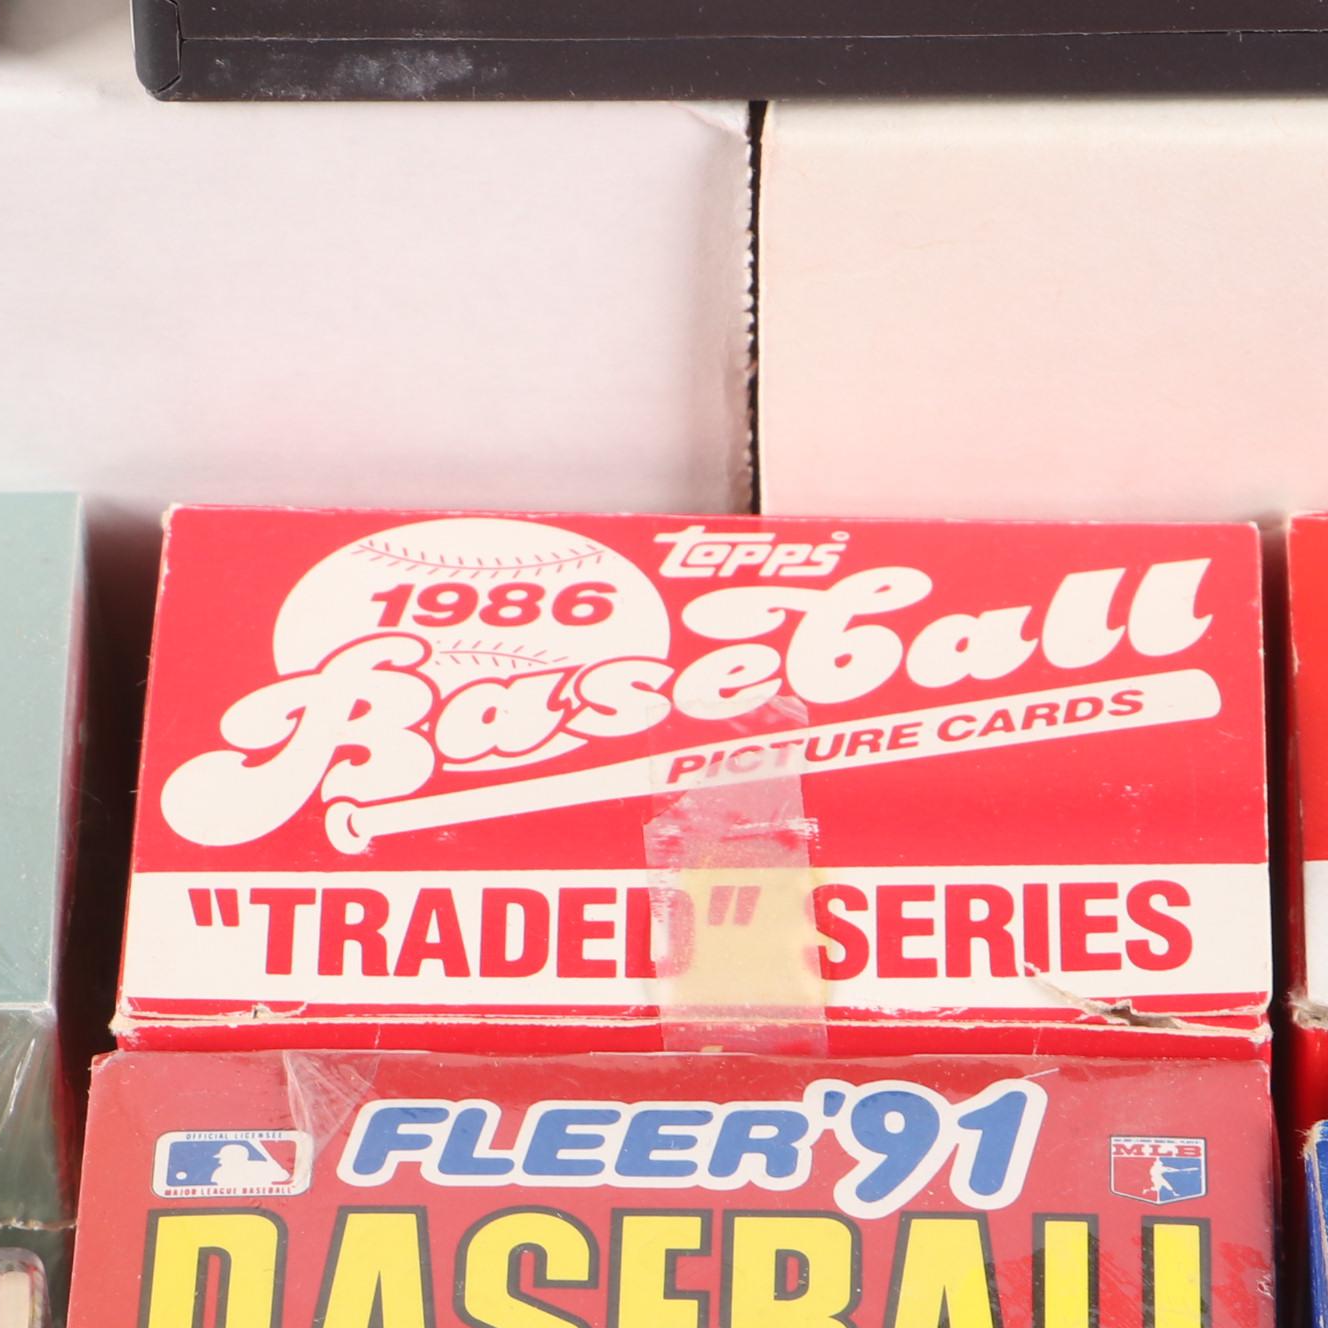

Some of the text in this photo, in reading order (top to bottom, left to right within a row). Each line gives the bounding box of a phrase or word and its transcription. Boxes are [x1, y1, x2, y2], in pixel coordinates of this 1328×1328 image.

[372, 581, 620, 628] 1986
[161, 559, 1216, 847] Baseball
[665, 687, 1144, 785] PICTURE CARDS
[187, 880, 1193, 980] "TRADED" SERIES
[186, 1132, 229, 1140] OFFICIAL
[1112, 1143, 1202, 1157] MLB
[164, 1186, 292, 1196] MAJOR LEAGUE BASEBALL
